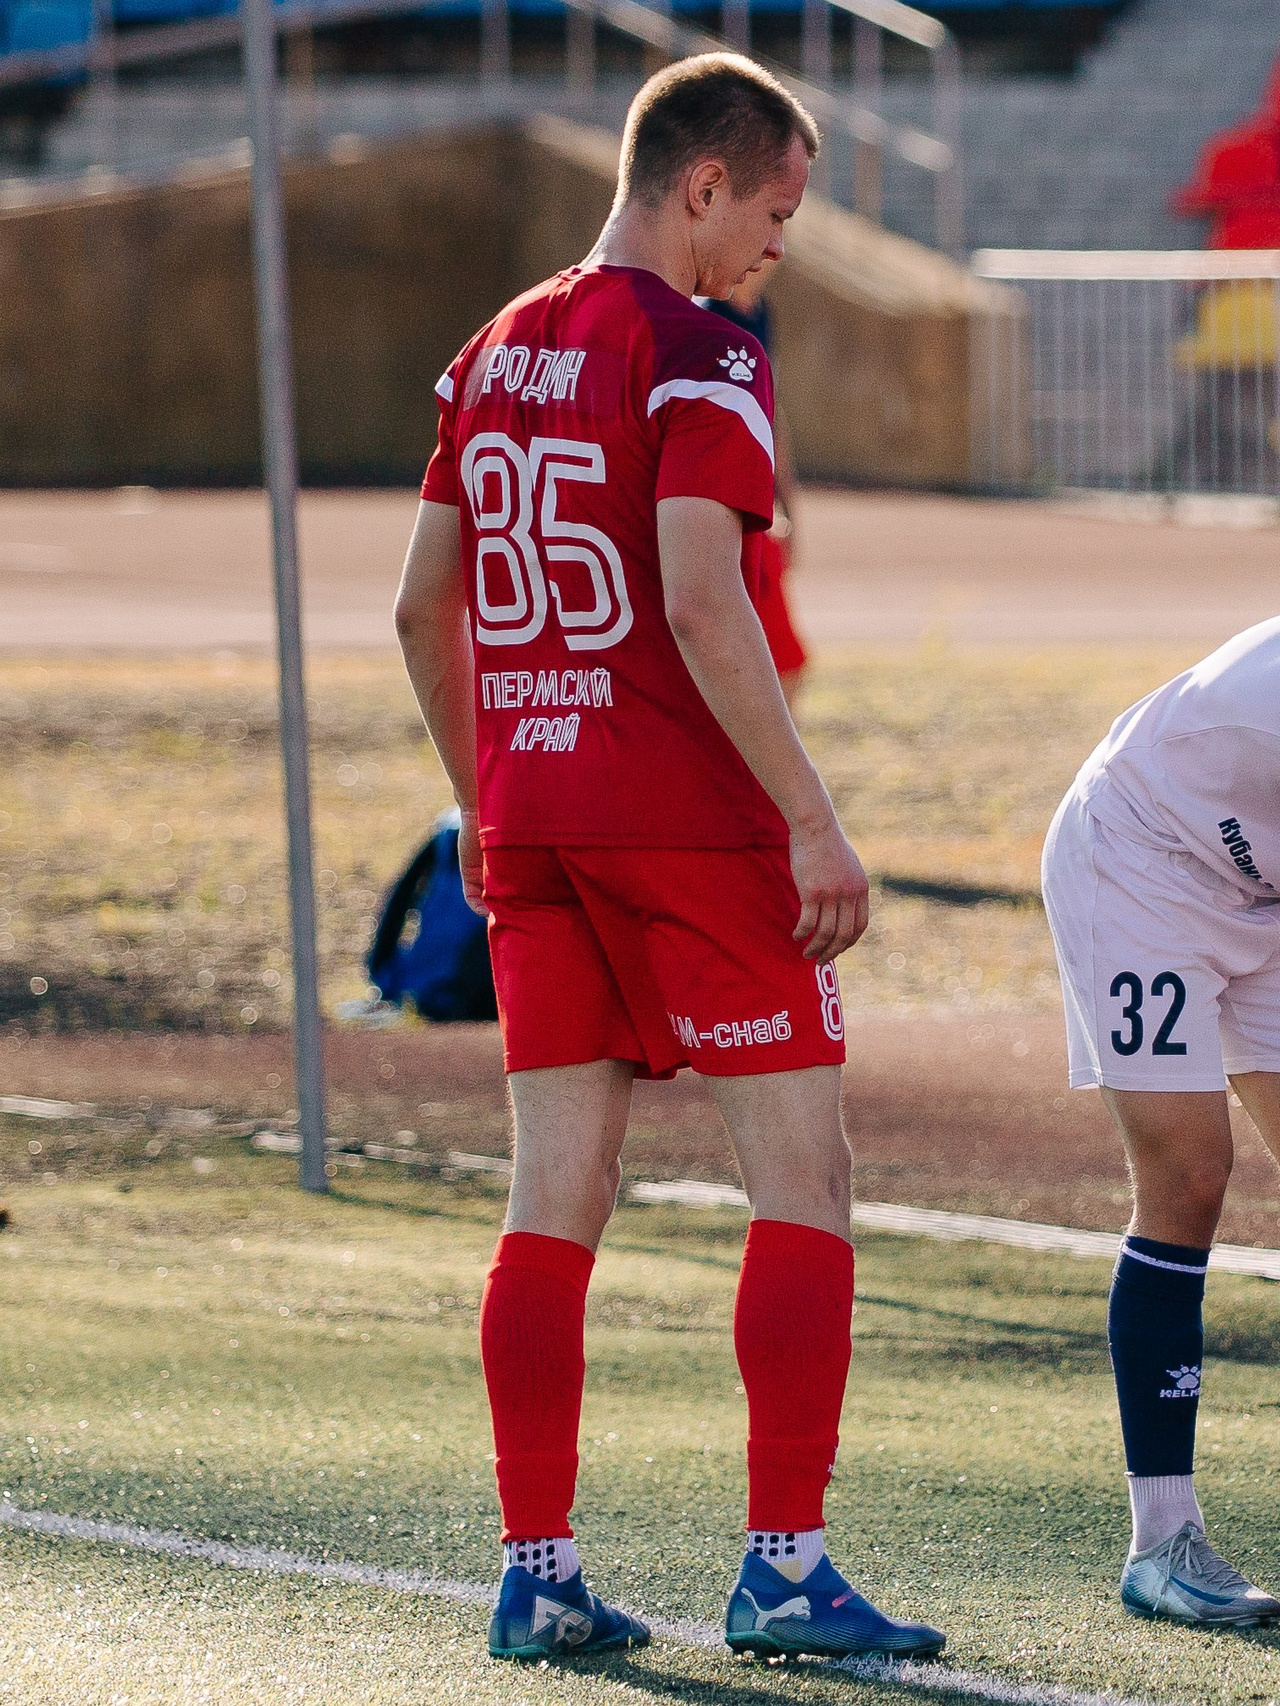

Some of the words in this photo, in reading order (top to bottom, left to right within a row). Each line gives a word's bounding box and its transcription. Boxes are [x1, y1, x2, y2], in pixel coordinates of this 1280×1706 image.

[460, 432, 634, 651] 85
[510, 712, 580, 752] КРАЙ
[815, 960, 844, 1041] 8
[1109, 970, 1188, 1057] 32
